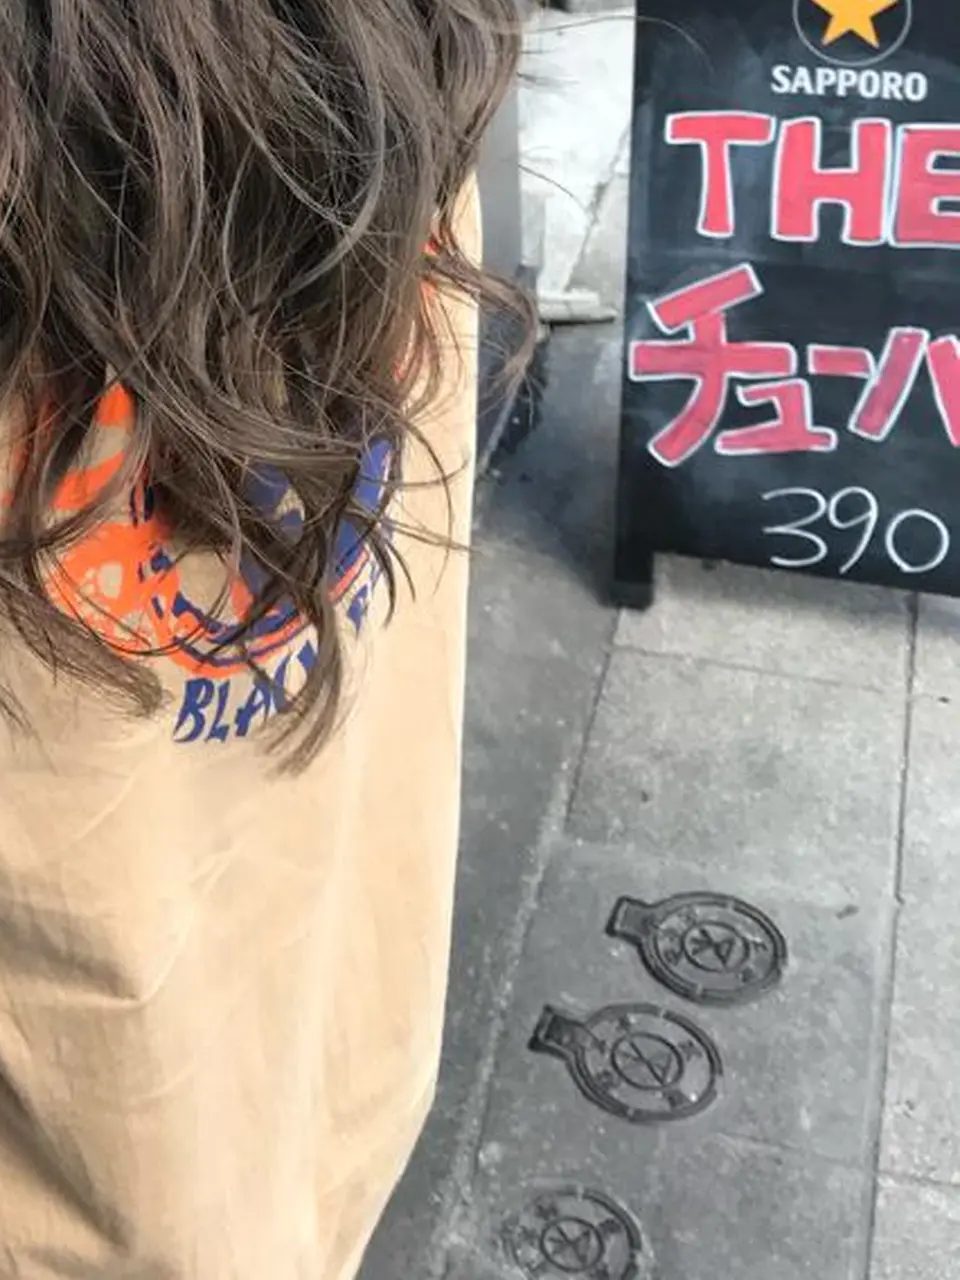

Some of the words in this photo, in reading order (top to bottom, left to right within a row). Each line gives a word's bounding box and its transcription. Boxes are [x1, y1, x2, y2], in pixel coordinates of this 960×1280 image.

[771, 65, 928, 103] SAPPORO
[665, 110, 960, 249] THE
[761, 485, 951, 573] 390
